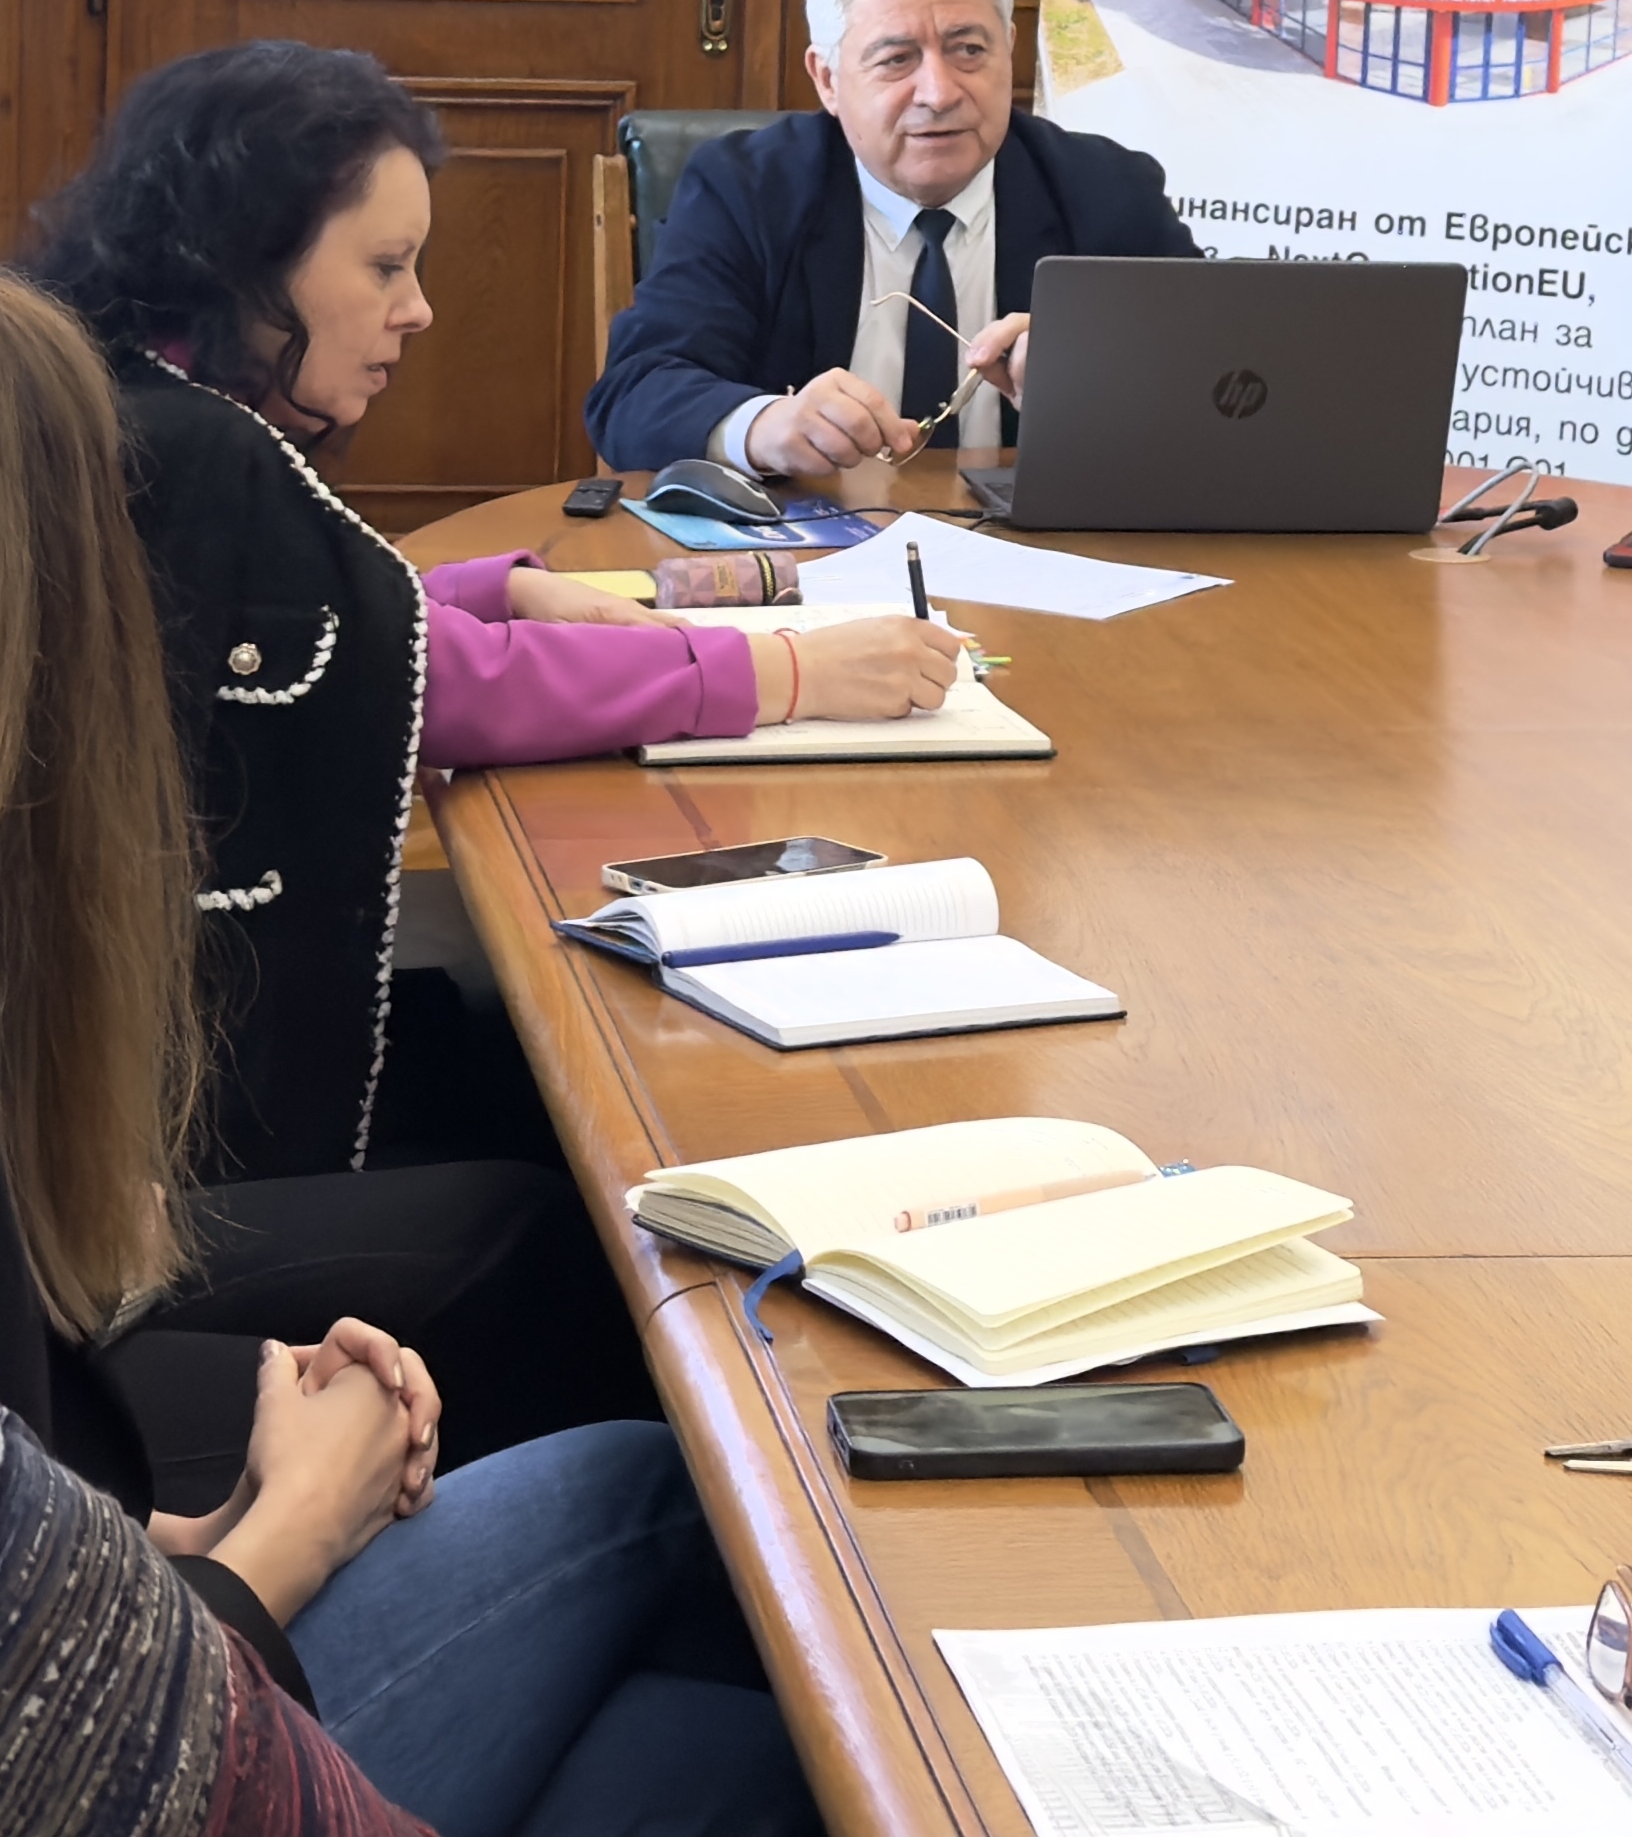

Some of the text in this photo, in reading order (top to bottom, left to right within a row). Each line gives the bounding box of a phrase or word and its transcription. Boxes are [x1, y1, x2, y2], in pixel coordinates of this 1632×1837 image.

[1168, 196, 1358, 233] инансиран
[1374, 211, 1427, 238] от
[1555, 323, 1593, 348] за
[1213, 369, 1268, 420] hp
[1452, 409, 1542, 444] ария,
[1558, 419, 1600, 445] по
